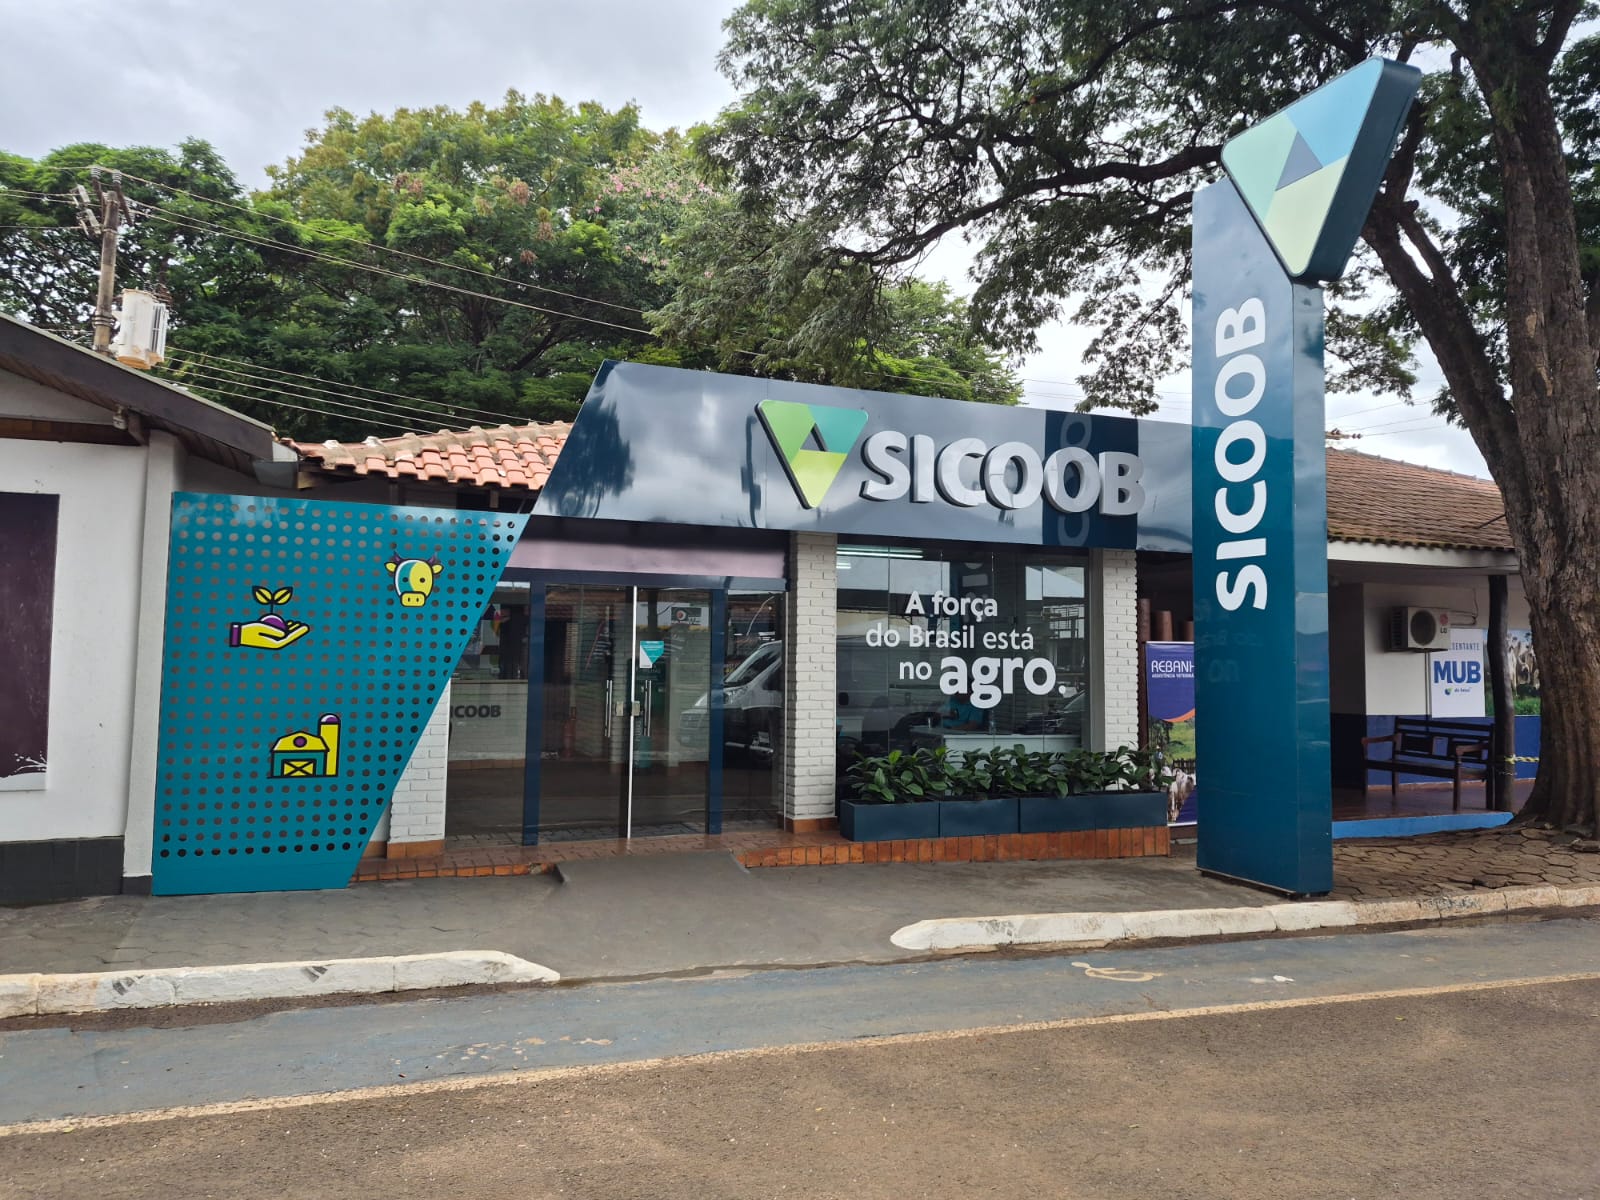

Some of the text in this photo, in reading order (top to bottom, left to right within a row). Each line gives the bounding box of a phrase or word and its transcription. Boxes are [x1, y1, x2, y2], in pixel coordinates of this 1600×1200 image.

[859, 430, 1146, 516] SICOOB
[1214, 297, 1267, 612] SICOOB
[904, 590, 998, 622] A força
[865, 622, 1034, 650] do Brasil está
[899, 655, 1067, 709] no agro.
[1433, 661, 1481, 683] MUB
